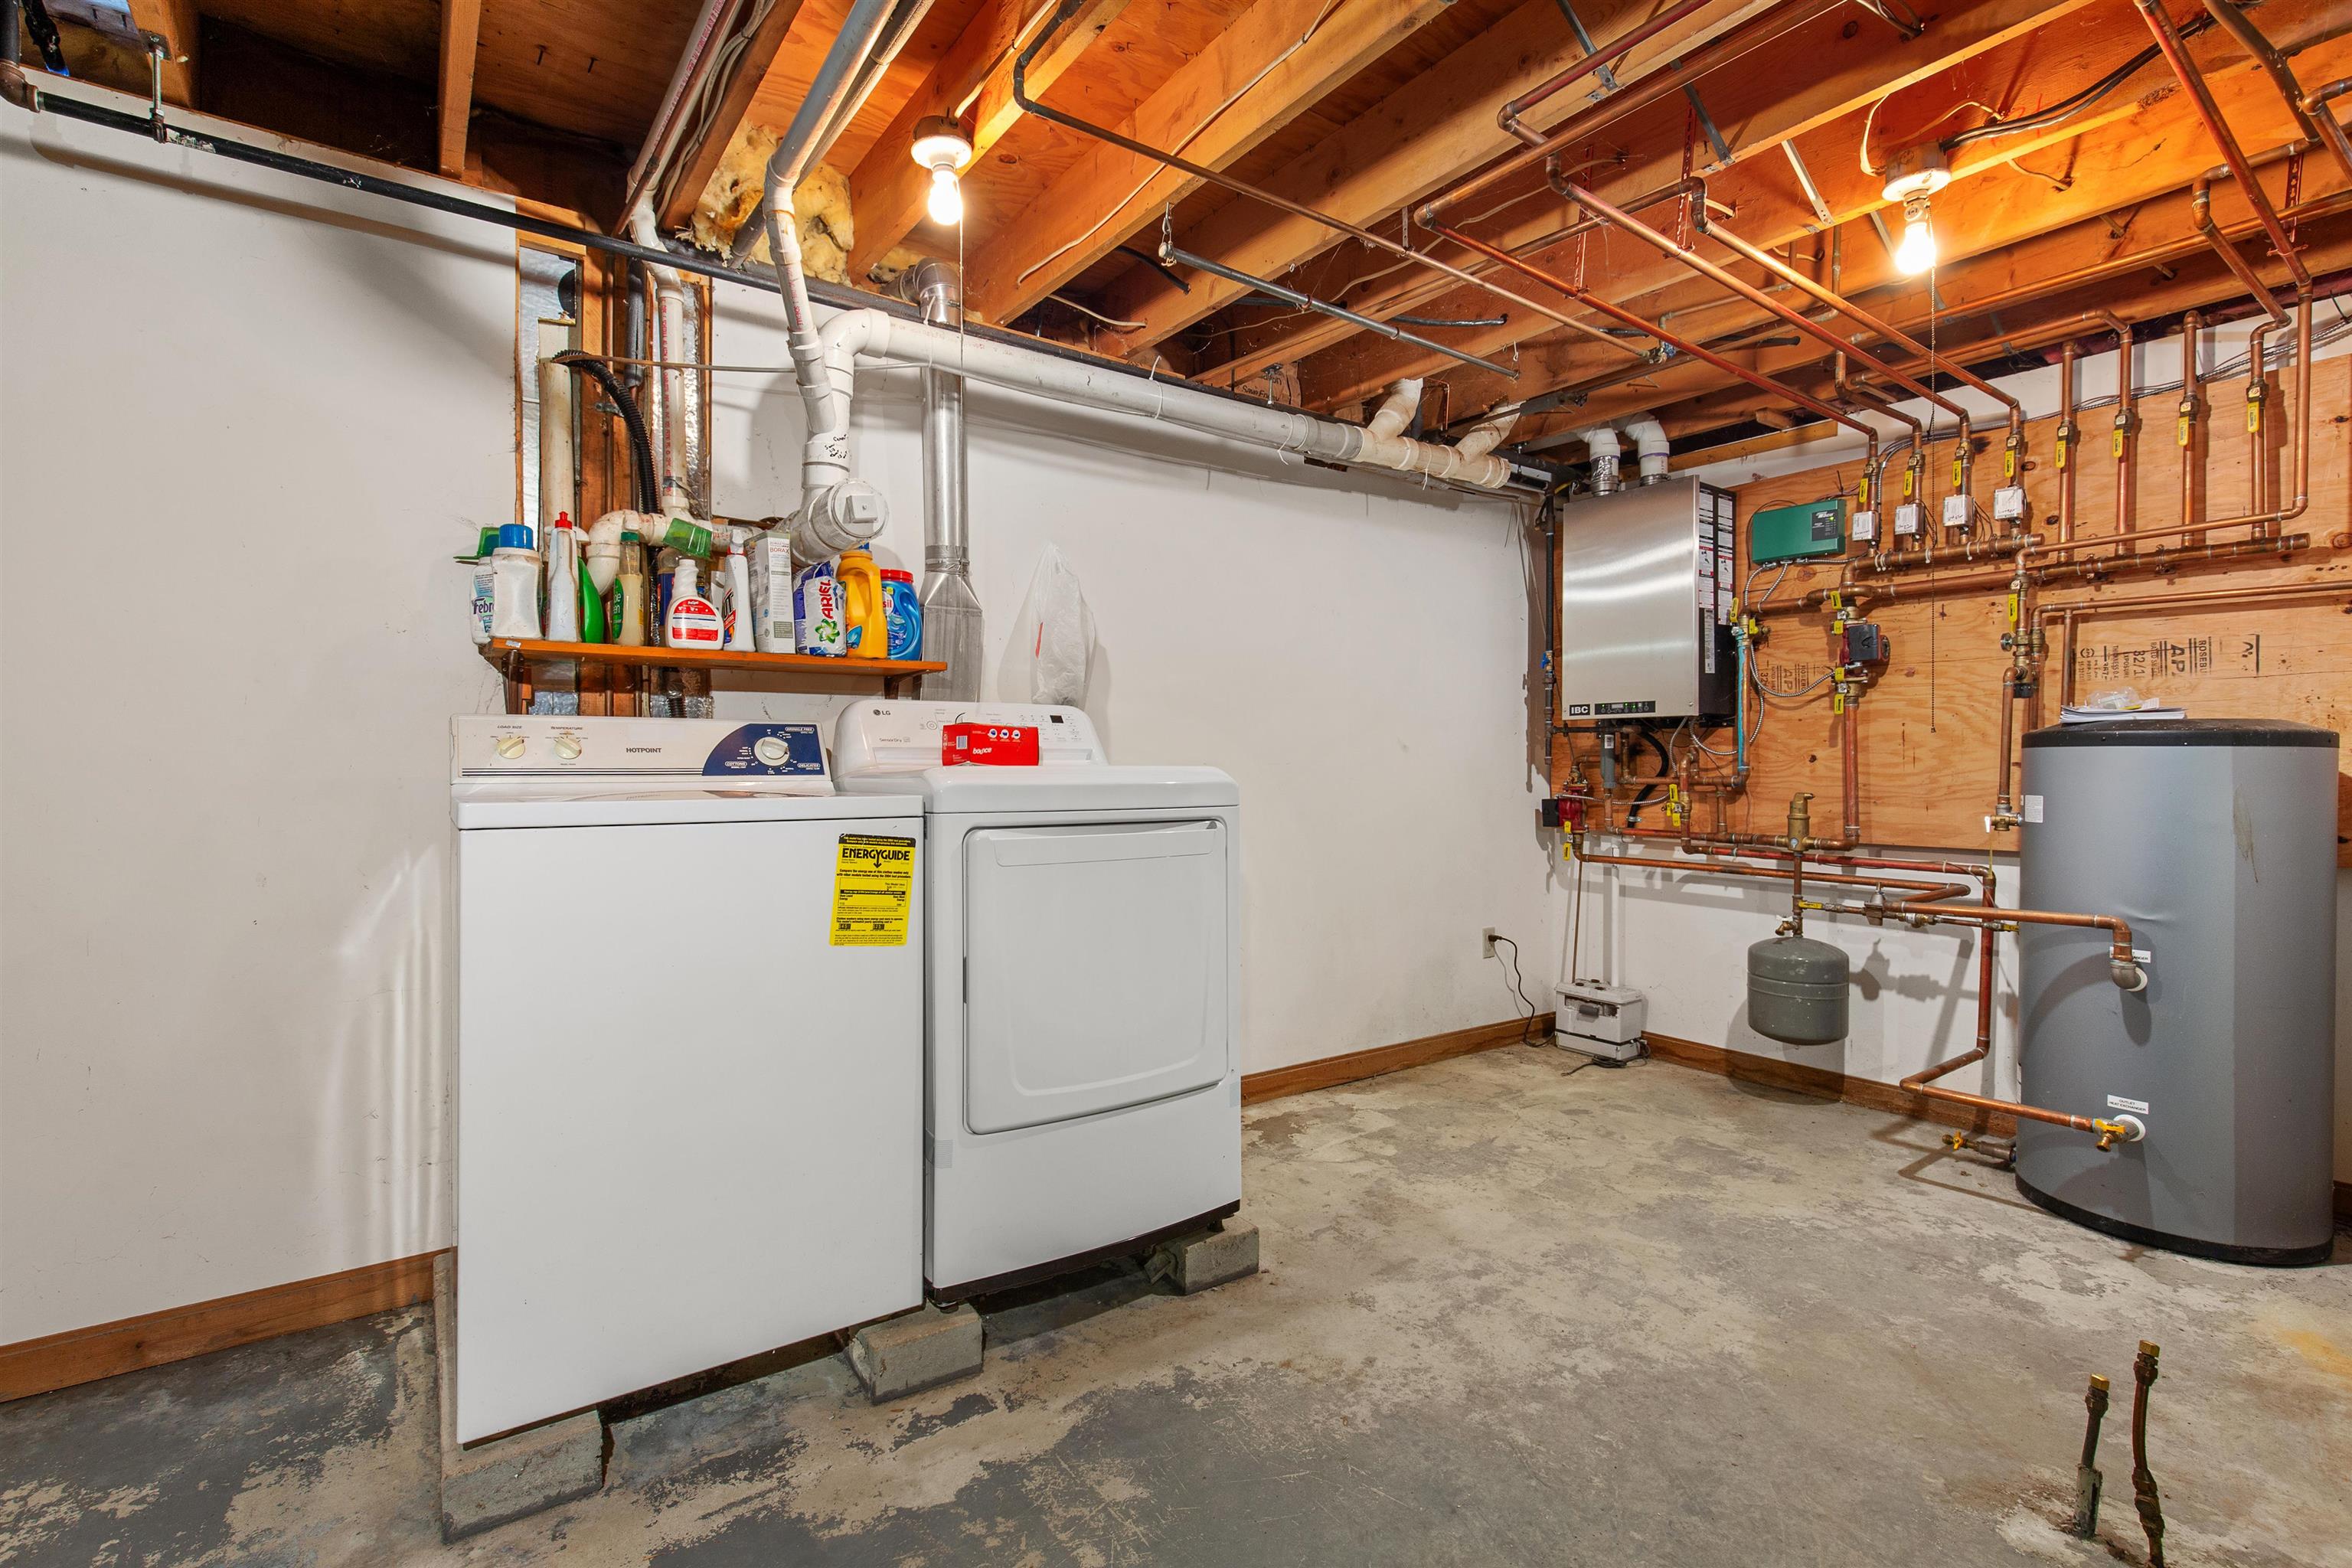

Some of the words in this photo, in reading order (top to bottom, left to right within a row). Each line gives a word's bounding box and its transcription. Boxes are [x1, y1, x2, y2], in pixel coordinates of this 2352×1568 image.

[818, 579, 835, 619] ARIEL
[1570, 706, 1589, 714] IBC
[841, 848, 910, 861] ENERGYGUIDE
